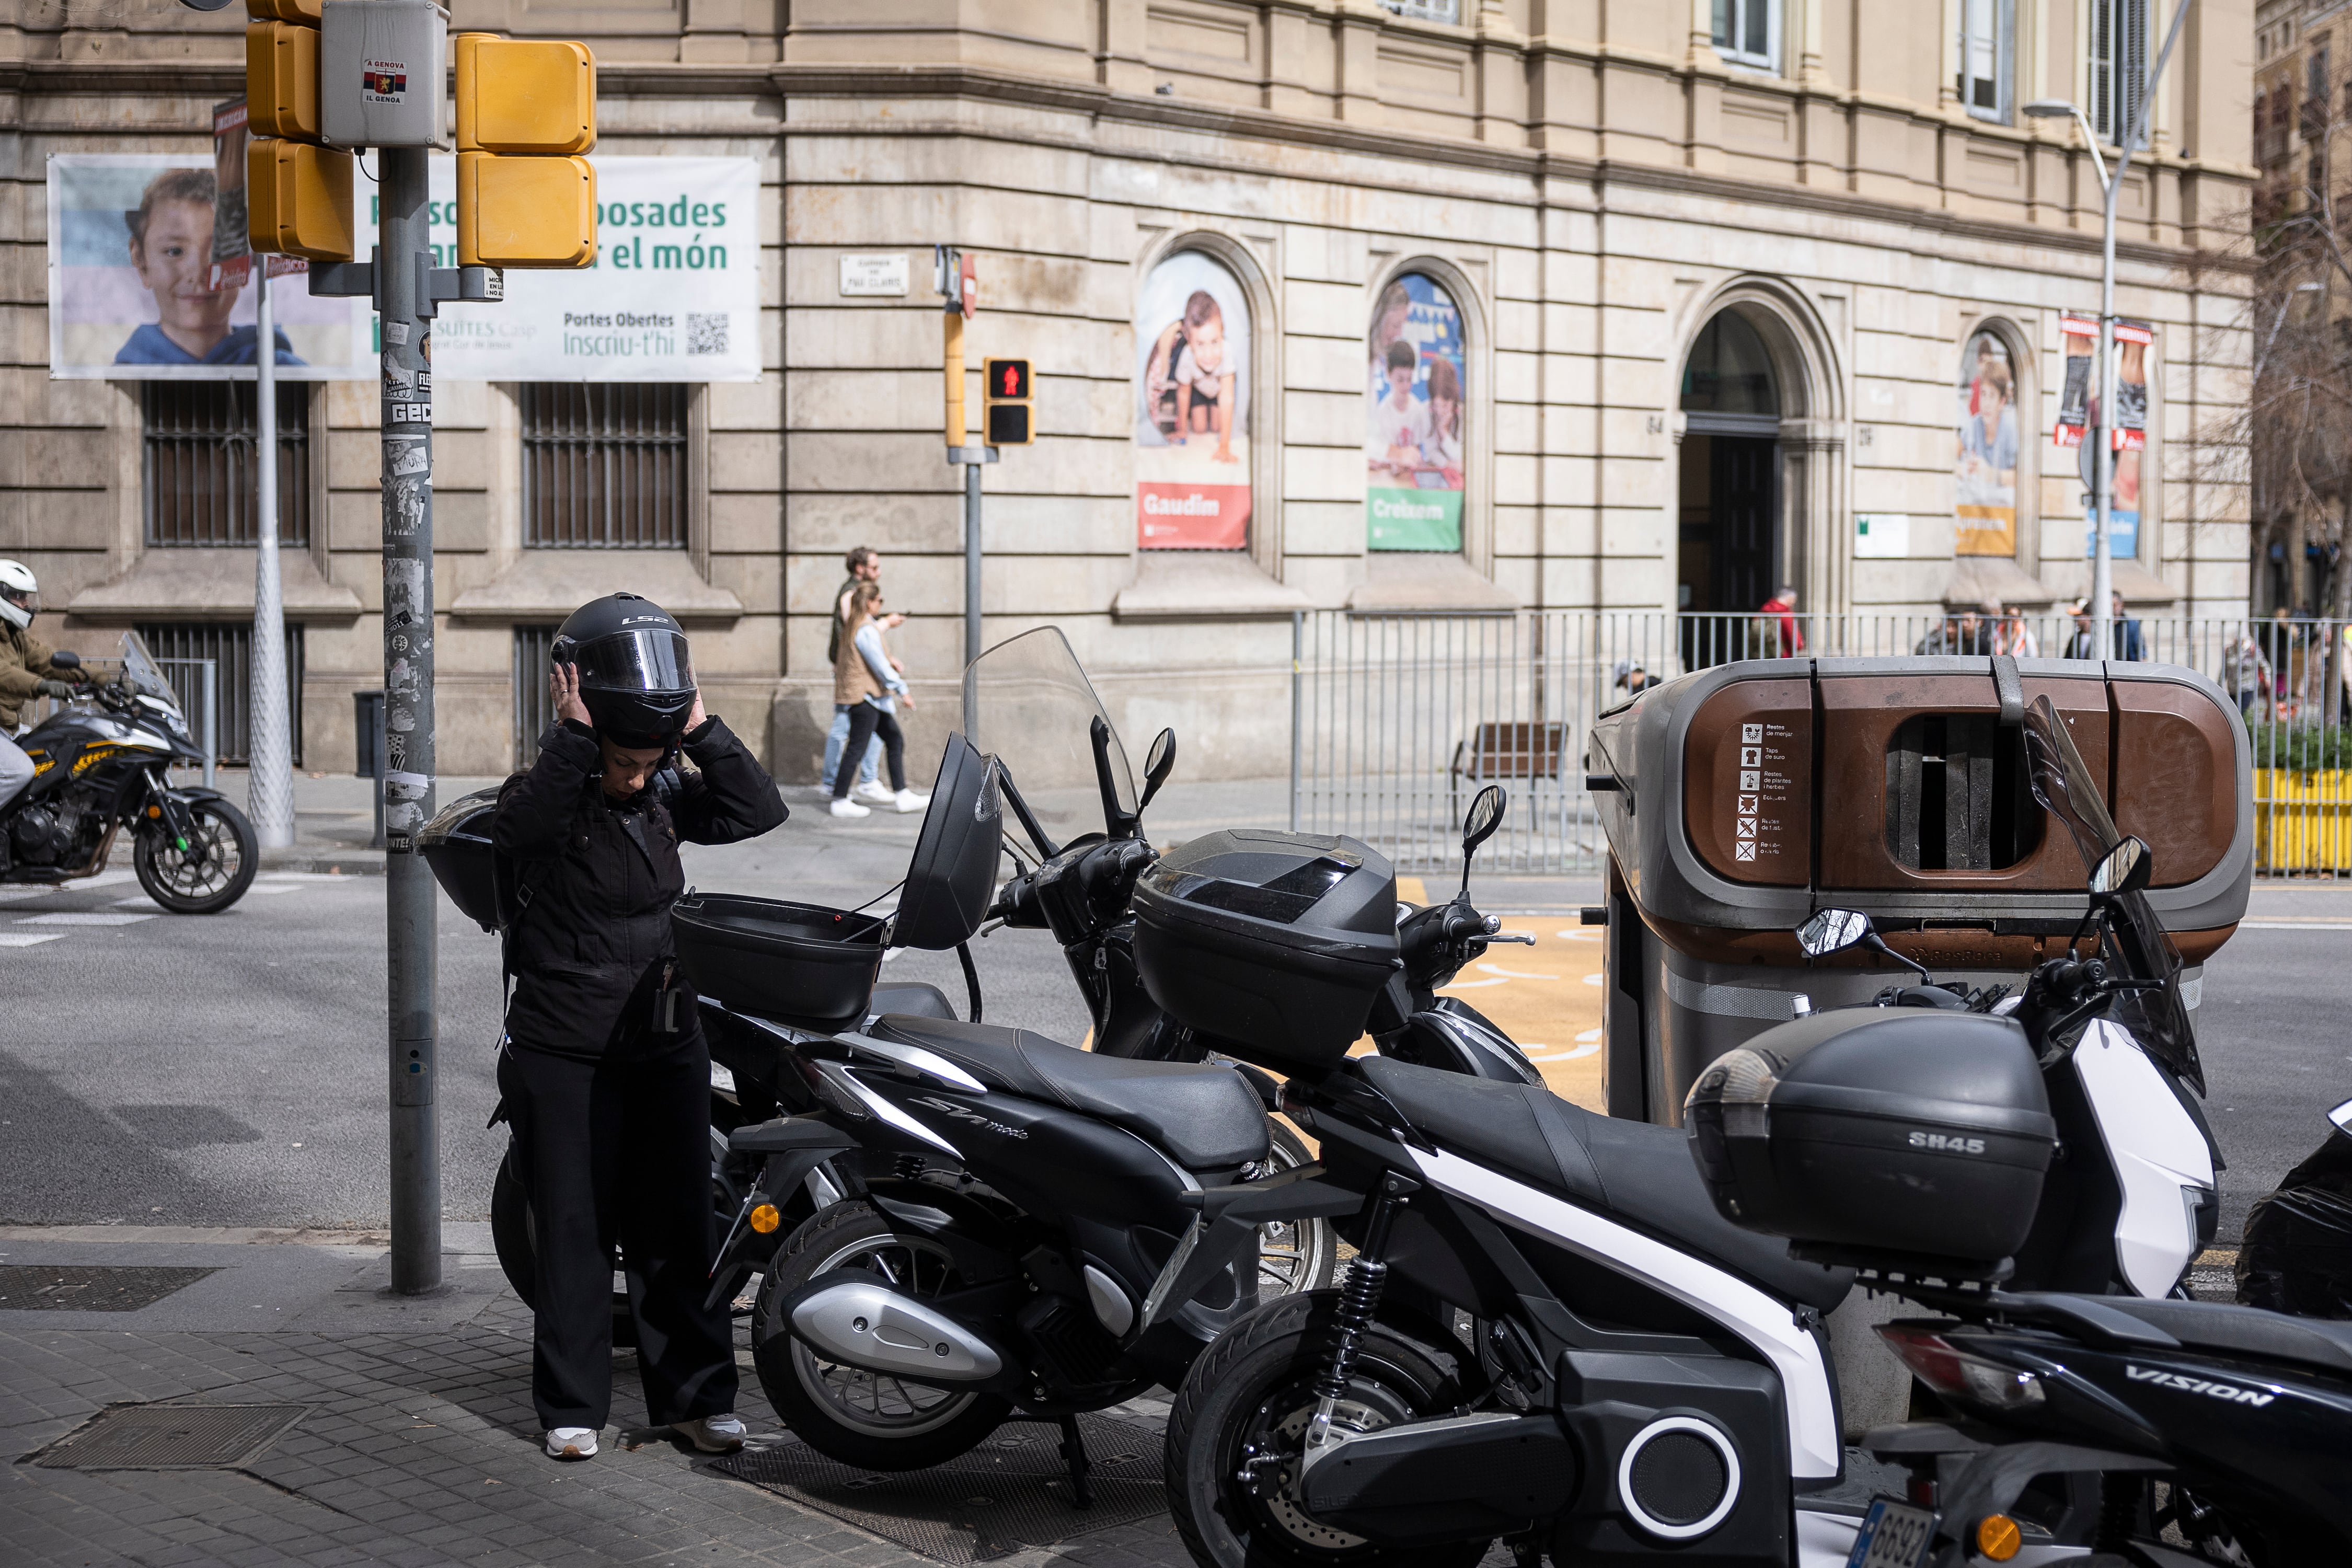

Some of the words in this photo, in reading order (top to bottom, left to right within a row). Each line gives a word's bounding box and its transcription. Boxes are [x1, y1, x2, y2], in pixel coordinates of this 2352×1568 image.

[613, 236, 642, 268] el
[653, 234, 725, 268] món
[564, 313, 611, 327] Portes
[616, 313, 674, 327] Obertes
[622, 616, 668, 625] LS2
[985, 1121, 1029, 1139] mode
[1909, 1132, 1985, 1154] SH45
[2126, 1365, 2275, 1406] VISION
[1872, 1513, 1927, 1567] 6692
